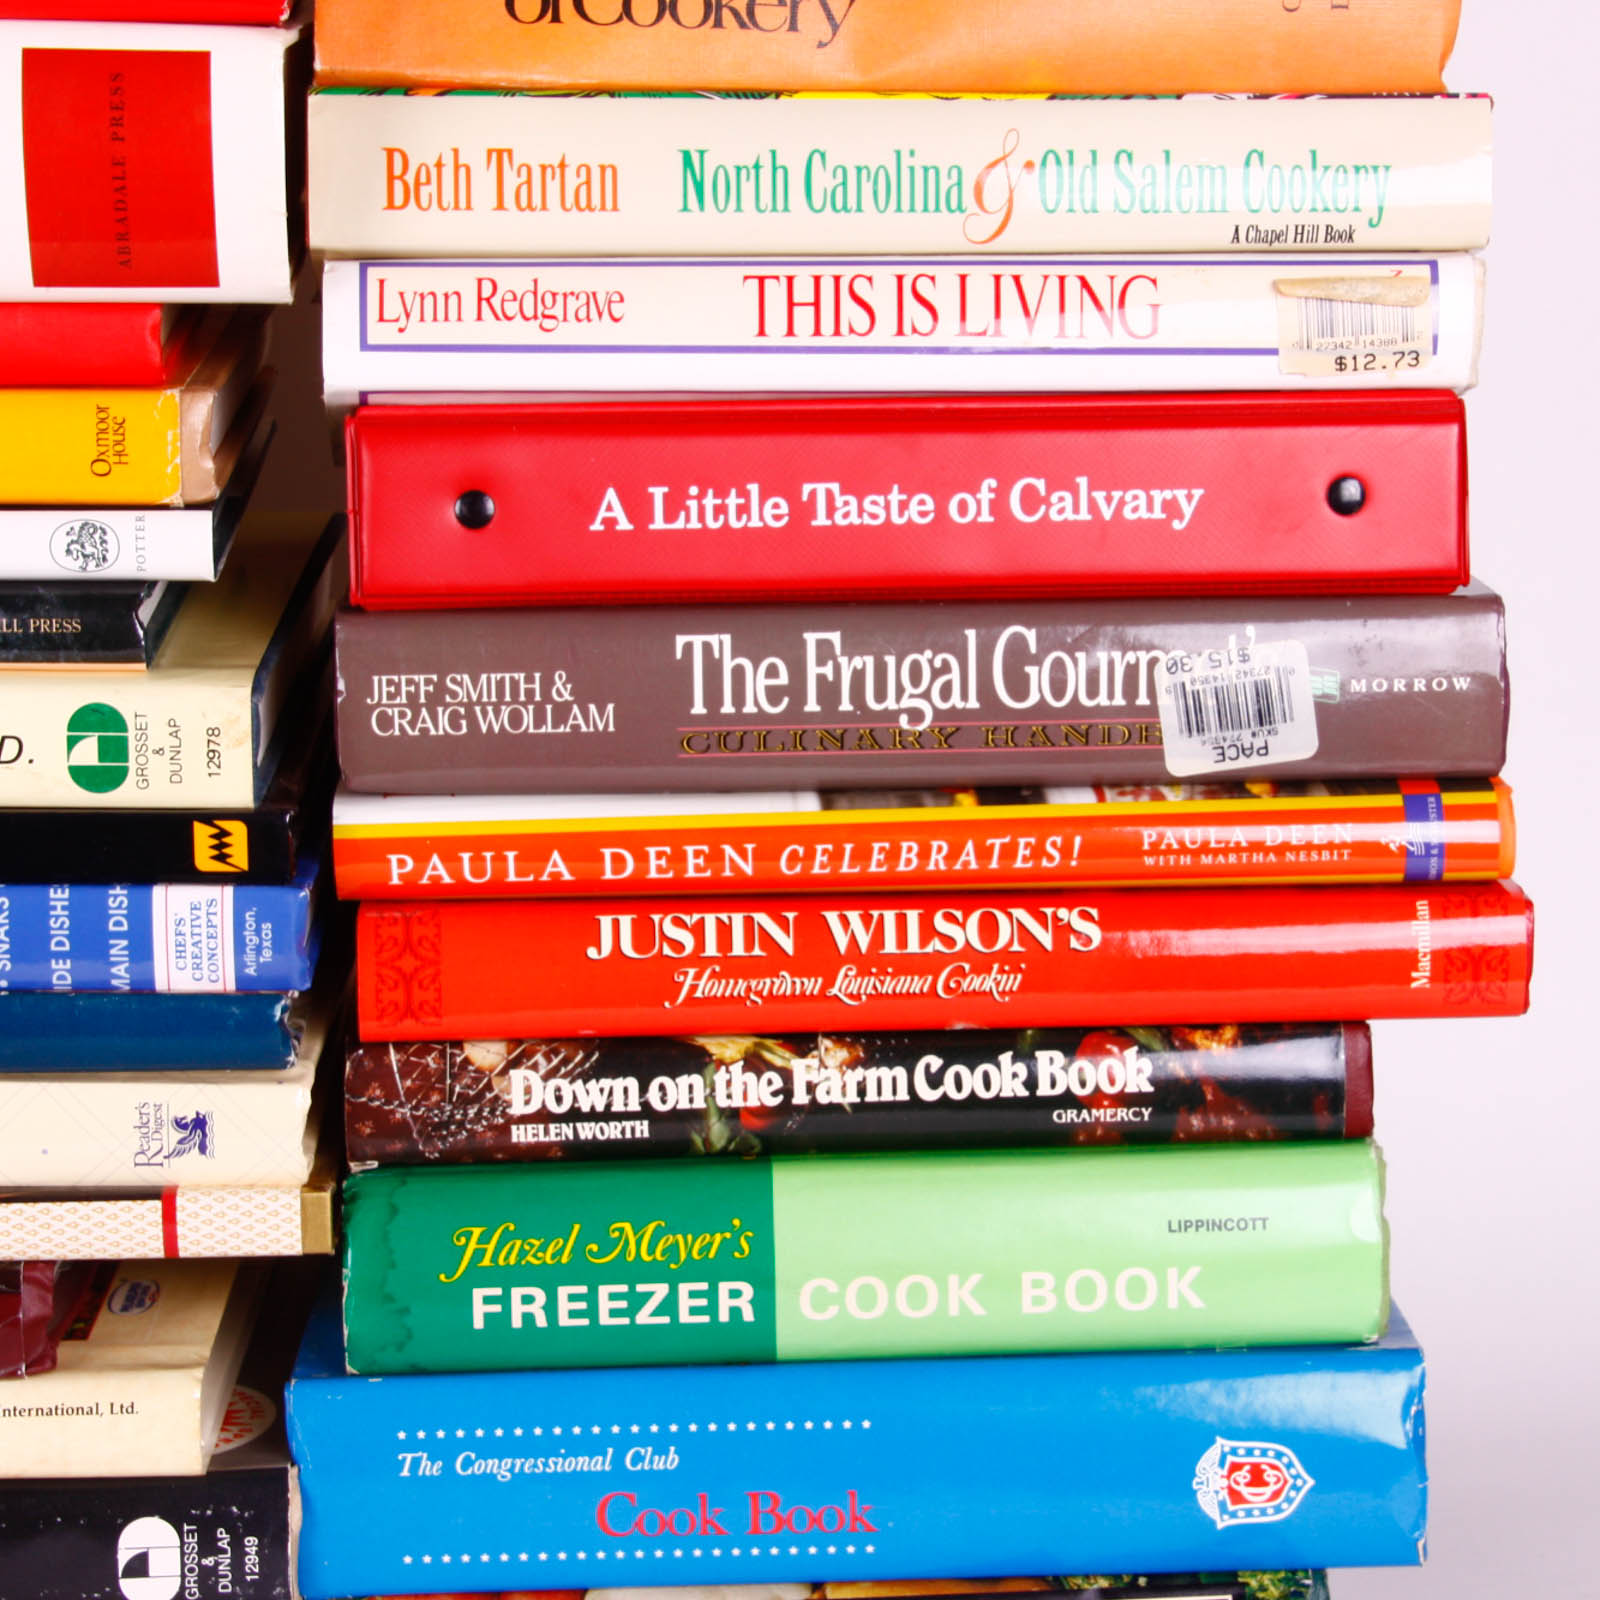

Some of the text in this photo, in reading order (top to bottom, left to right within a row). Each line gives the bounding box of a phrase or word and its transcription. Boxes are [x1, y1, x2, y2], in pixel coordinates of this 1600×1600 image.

[109, 71, 133, 271] ABRADALE PRESS
[382, 147, 620, 212] Beth Tartan
[678, 128, 1391, 245] North Carolina & Old Salem Cookery
[1231, 224, 1356, 247] A Chapel Hill Book
[376, 276, 625, 333] Lynn Redgrave
[742, 273, 1161, 339] THIS IS LIVING
[1335, 350, 1420, 372] $12.73
[90, 404, 112, 478] Oxmoor
[112, 415, 129, 466] House
[589, 476, 1205, 531] A Little Taste of Calvary
[136, 512, 147, 572] POTTER
[0, 618, 82, 633] LL PRESS
[675, 632, 789, 715] The
[803, 629, 981, 732] Frugal
[1166, 647, 1251, 675] $15.30
[1349, 676, 1471, 693] MORROW
[367, 670, 574, 705] JEFF SMITH &
[371, 703, 616, 737] CRAIG WOLLAM
[681, 727, 961, 755] CULINARY
[135, 712, 150, 790] GROSSET
[152, 747, 165, 757] &
[169, 718, 184, 785] DUNLAP
[206, 726, 222, 778] 12978
[1212, 739, 1269, 763] PACE
[387, 835, 1084, 886] PAULA DEEN CELEBRATES!
[1142, 822, 1354, 850] PAULA DEEN
[1143, 848, 1352, 867] WITH MARTHA NESBIT
[191, 901, 204, 982] CREATIVE
[206, 898, 220, 983] CONCEPTS
[243, 907, 258, 976] Arlington,
[259, 922, 273, 963] Texas
[586, 907, 1102, 960] JUSTIN WILSON'S
[1410, 900, 1431, 989] Macmillan
[665, 966, 823, 1009] Homegrown
[826, 965, 932, 1005] Louisiana
[509, 1045, 1155, 1115] Down on the Farm Cook Book
[133, 1101, 164, 1168] Reader's
[151, 1103, 163, 1147] Digest
[511, 1119, 650, 1144] HELEN WORTH
[1052, 1107, 1153, 1125] GRAMERCY
[439, 1218, 755, 1283] Hazel Meyer's
[1167, 1216, 1270, 1234] LIPPINCOTT
[472, 1266, 1207, 1330] FREEZER COOK BOOK
[110, 1401, 140, 1415] Ltd.
[397, 1446, 680, 1482] The Congressional Club
[596, 1489, 880, 1538] Cook Book
[184, 1523, 199, 1600] GROSSET
[201, 1557, 215, 1566] &
[217, 1528, 232, 1593] DUNLAP
[244, 1536, 260, 1582] 12949
